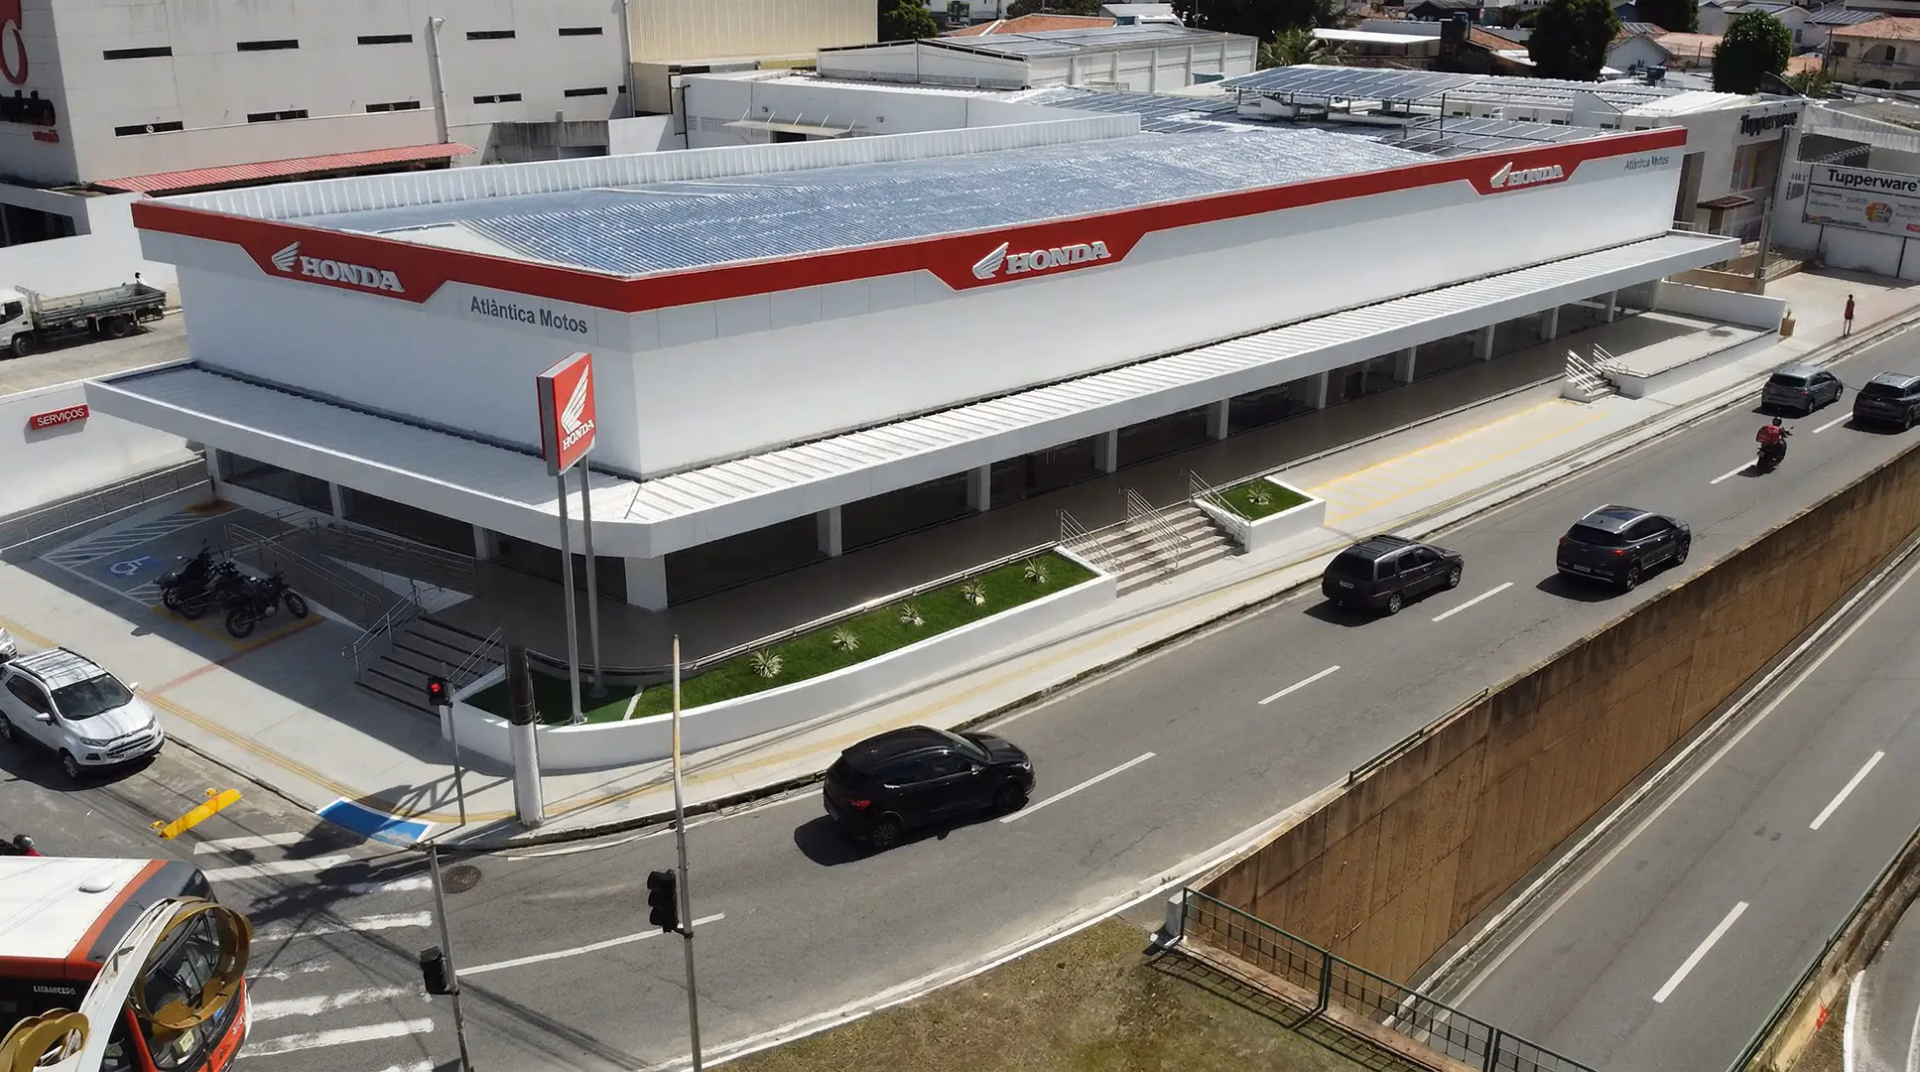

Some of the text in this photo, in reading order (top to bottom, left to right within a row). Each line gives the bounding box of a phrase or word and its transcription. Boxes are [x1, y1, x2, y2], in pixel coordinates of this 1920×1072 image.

[1508, 164, 1564, 186] HONDA
[1828, 169, 1917, 192] Tupperware
[1006, 241, 1111, 274] HONDA
[300, 256, 405, 293] HONDA
[471, 296, 588, 334] Atlântica Motos
[37, 408, 85, 426] SERVIÇOS
[562, 419, 595, 451] HONDA
